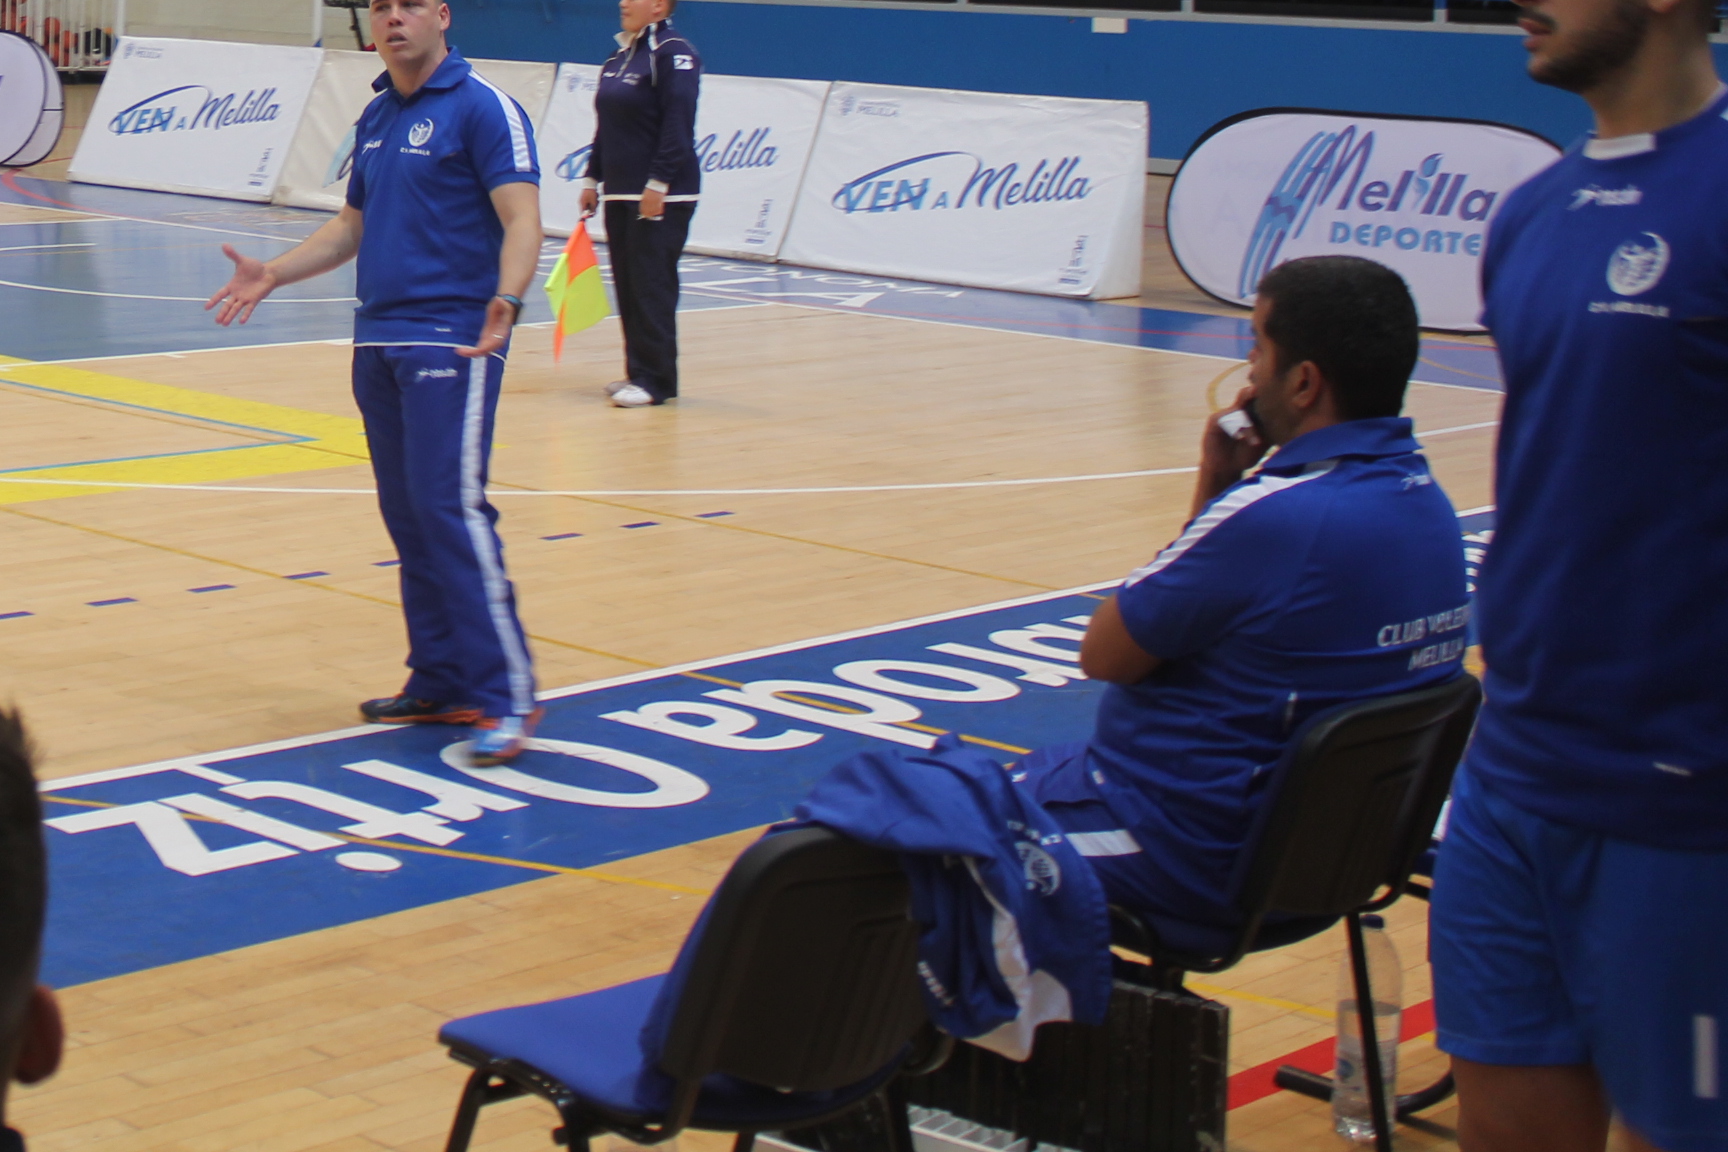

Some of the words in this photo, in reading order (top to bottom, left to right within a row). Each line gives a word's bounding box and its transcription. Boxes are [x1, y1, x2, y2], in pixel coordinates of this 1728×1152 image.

[116, 105, 178, 136] VEN
[172, 115, 189, 132] A
[188, 86, 283, 131] Melilla
[840, 177, 932, 215] VEN
[930, 190, 950, 210] A
[954, 154, 1093, 211] Melilla
[1328, 220, 1483, 257] DEPORTE
[1377, 617, 1427, 647] CLUB
[1427, 601, 1471, 634] VOLE
[598, 614, 1094, 752] broda
[43, 736, 711, 877] Ortiz
